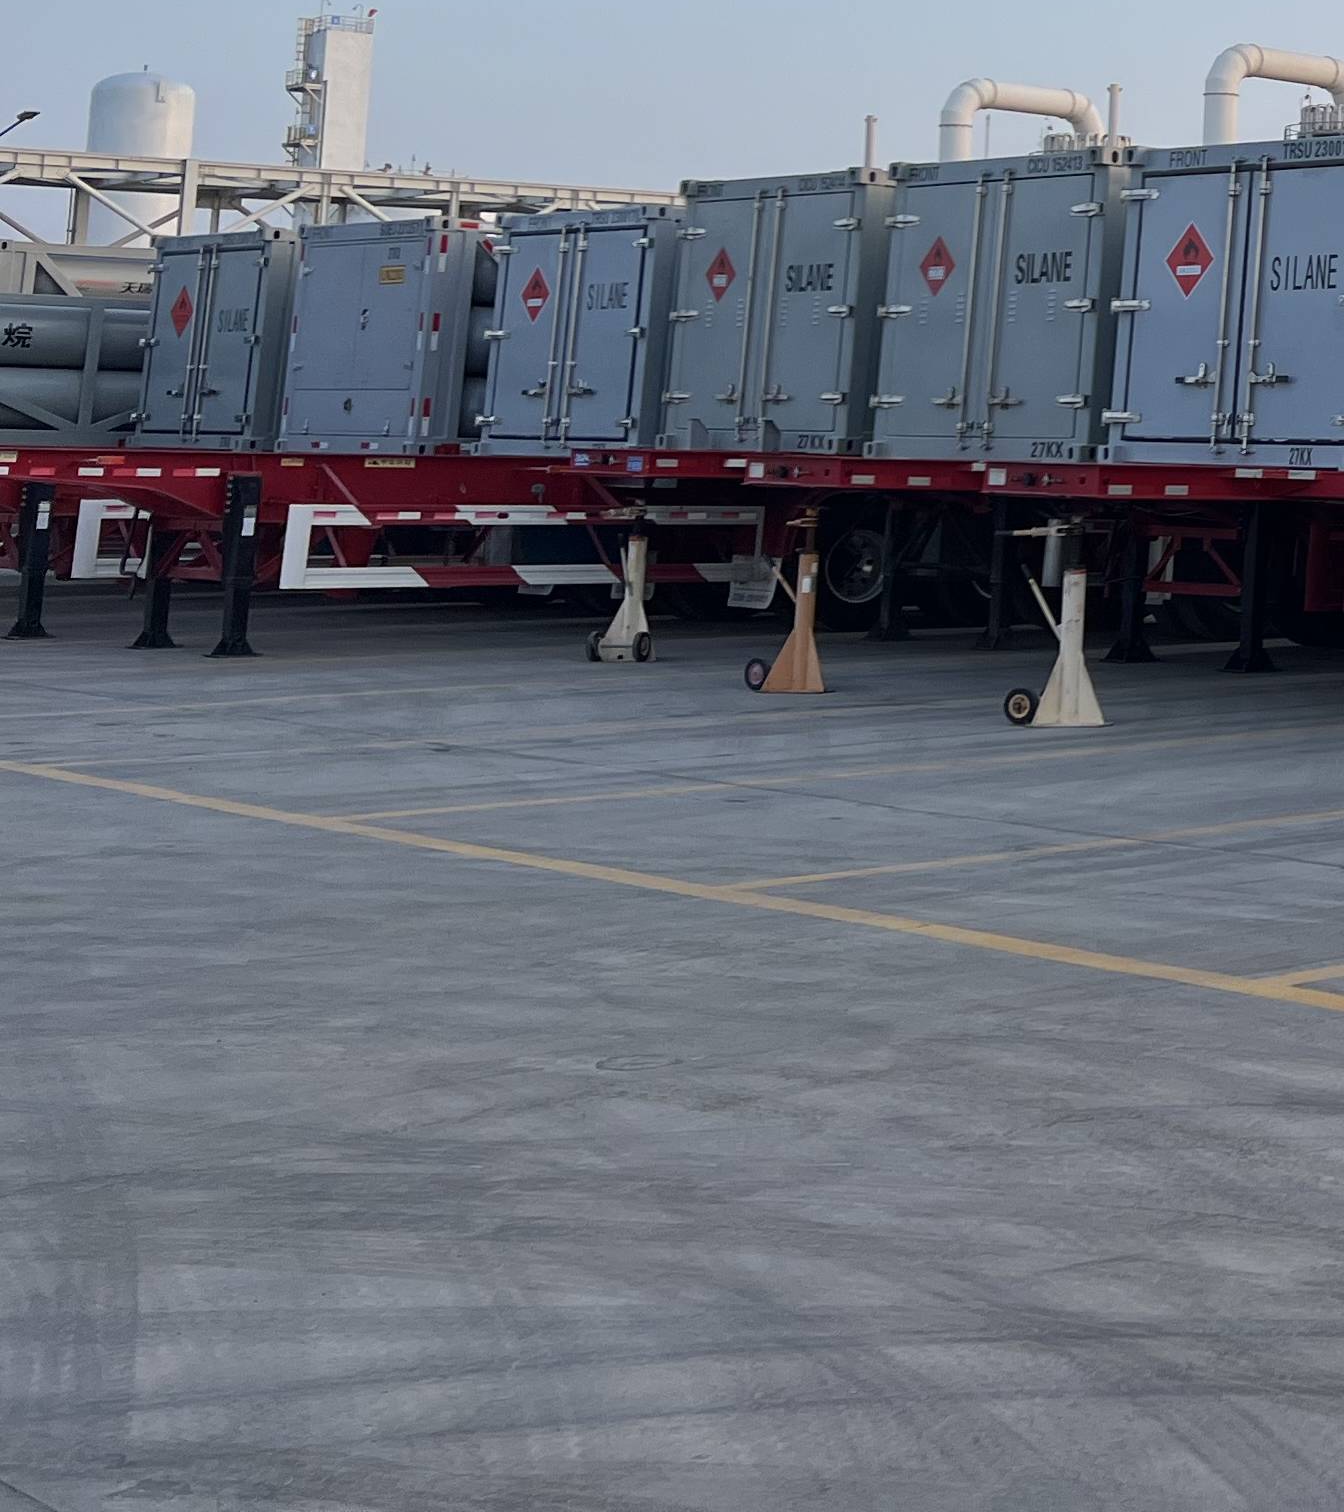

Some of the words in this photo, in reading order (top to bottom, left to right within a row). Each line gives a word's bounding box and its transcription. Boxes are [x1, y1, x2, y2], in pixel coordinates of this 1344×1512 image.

[1169, 149, 1208, 168] FRONT
[1283, 141, 1312, 160] TRSU
[785, 263, 835, 293] SILANE
[1014, 251, 1073, 285] SILANE
[1270, 254, 1339, 292] SILANE
[586, 281, 630, 311] SILANE
[1030, 441, 1065, 460] 27KX
[1288, 447, 1313, 466] 27KX
